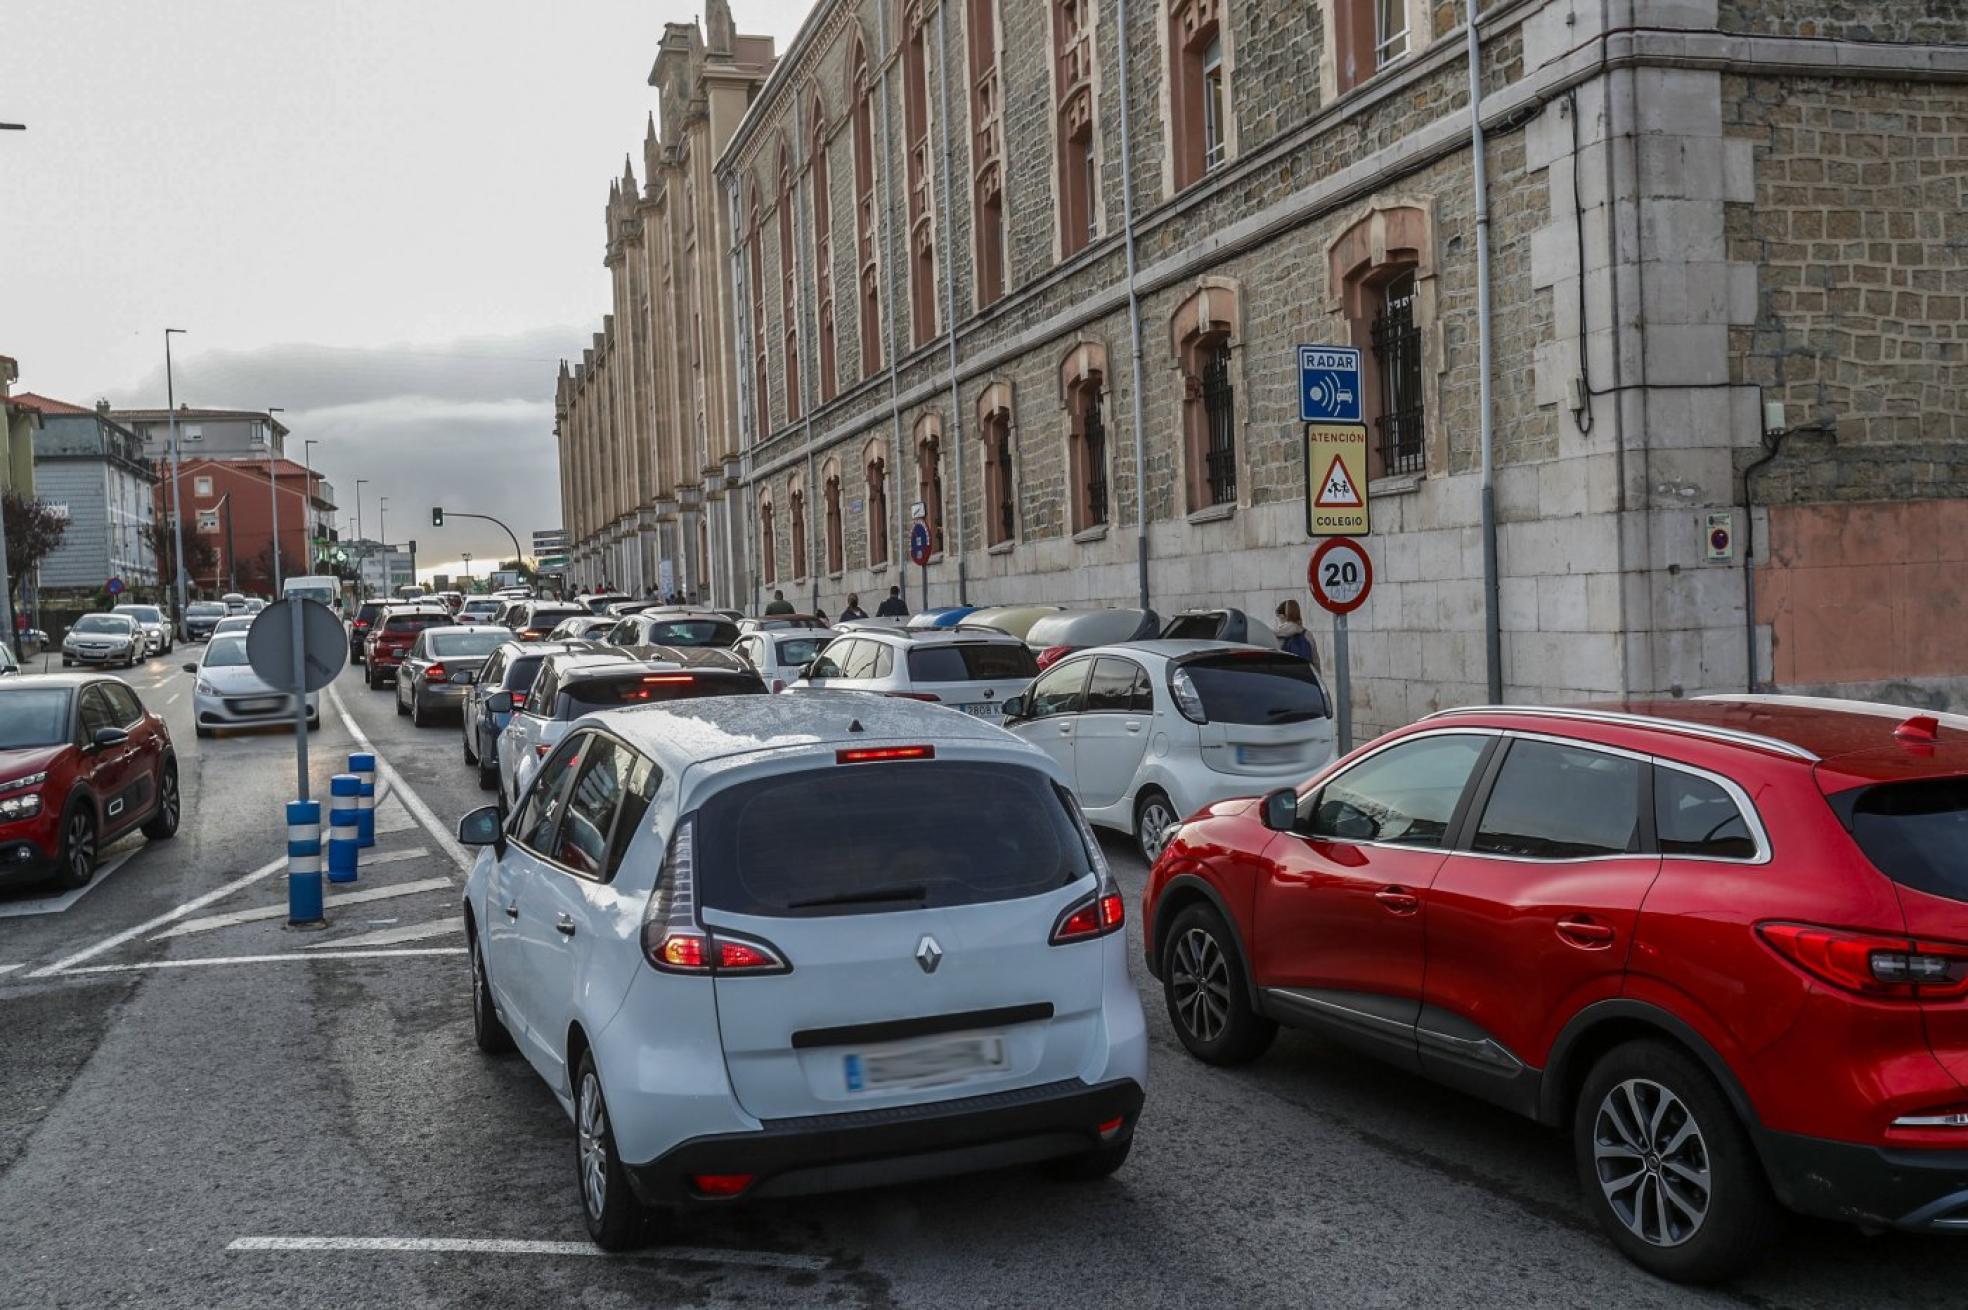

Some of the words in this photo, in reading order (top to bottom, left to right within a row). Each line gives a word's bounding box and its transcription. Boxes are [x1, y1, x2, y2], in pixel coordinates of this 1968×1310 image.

[1306, 355, 1353, 369] RADAR
[1311, 431, 1364, 443] ATENCIÓN
[1316, 516, 1363, 527] COLEGIO
[1324, 561, 1357, 587] 20
